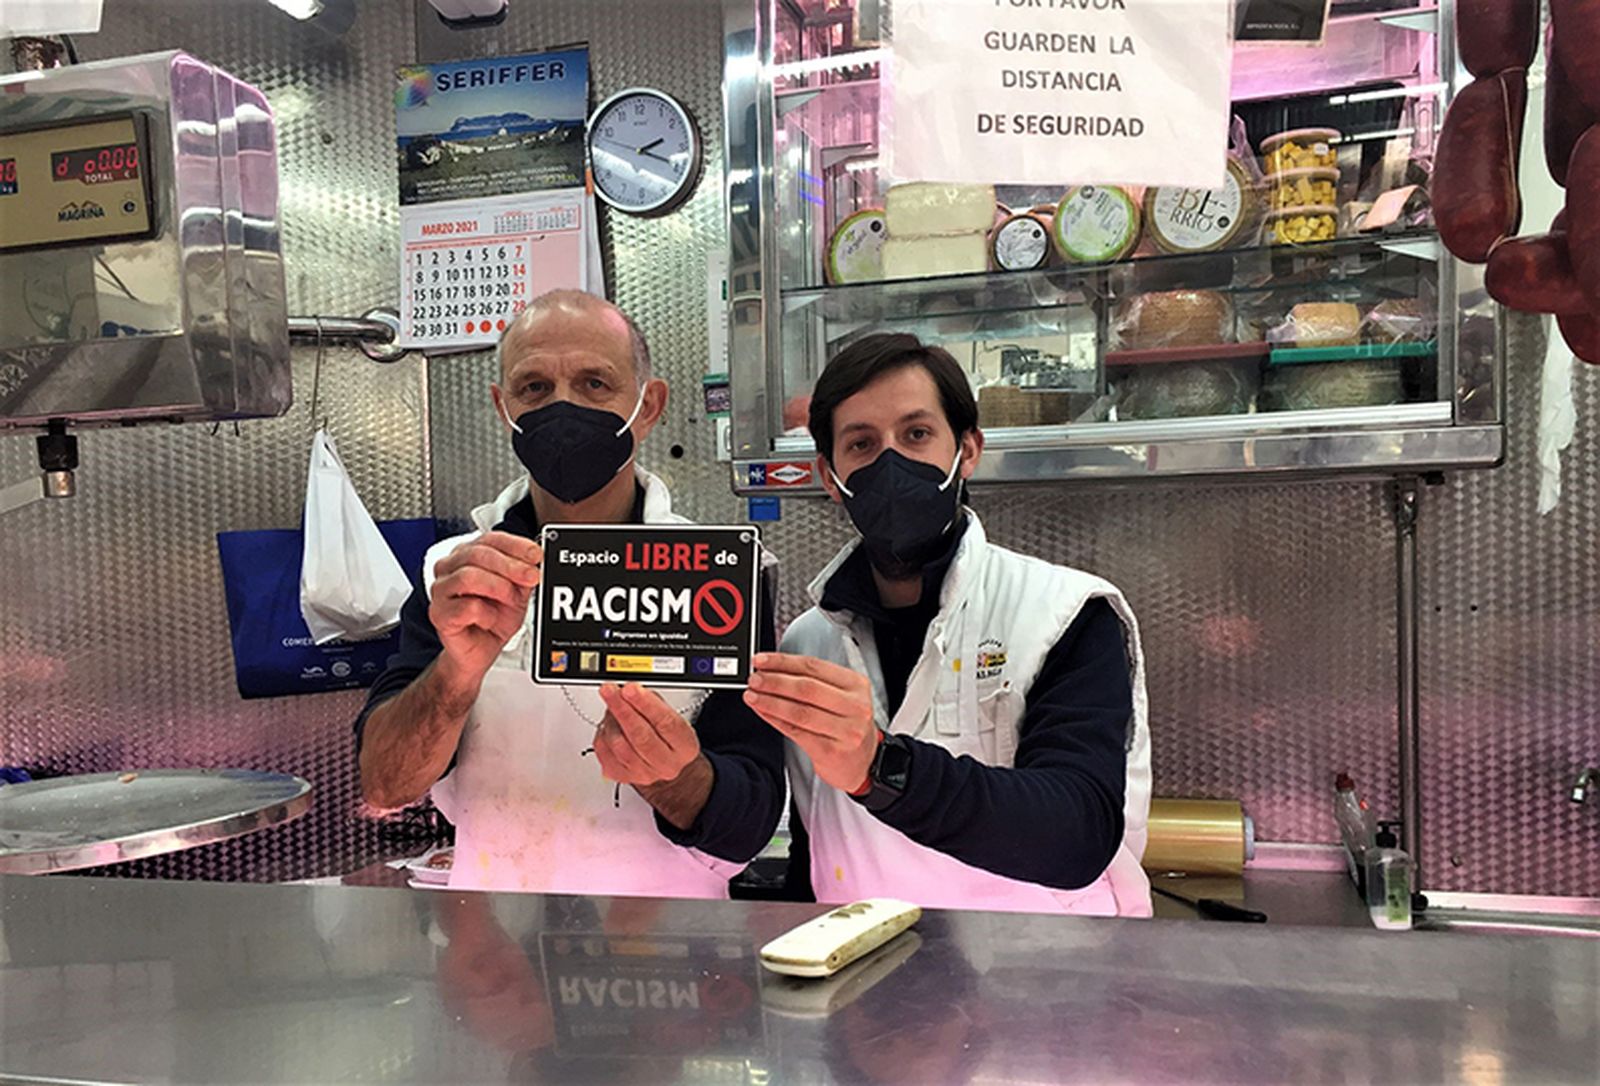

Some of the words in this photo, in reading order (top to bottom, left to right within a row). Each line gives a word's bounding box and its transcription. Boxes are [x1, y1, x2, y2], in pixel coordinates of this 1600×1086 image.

[984, 31, 1096, 53] GUARDEN
[1109, 36, 1135, 55] LA
[436, 62, 565, 92] SERIFFER
[1002, 70, 1122, 92] DISTANCIA
[634, 104, 645, 115] 12
[669, 118, 676, 129] 2
[977, 113, 1006, 134] DE
[1012, 114, 1145, 137] SEGURIDAD
[85, 174, 113, 182] TOTAL
[421, 222, 454, 236] MARZO
[455, 220, 478, 233] 2021
[417, 254, 422, 265] 1
[432, 252, 439, 264] 2
[449, 251, 455, 263] 3
[465, 250, 472, 262] 4
[482, 248, 488, 260] 5
[498, 247, 506, 259] 6
[515, 246, 522, 257] 7
[416, 272, 423, 284] 8
[432, 271, 439, 282] 9
[447, 270, 459, 281] 10
[464, 269, 474, 280] 11
[480, 267, 492, 279] 12
[497, 265, 508, 277] 13
[513, 264, 525, 276] 14
[414, 290, 426, 302] 15
[430, 289, 442, 300] 16
[447, 288, 459, 299] 17
[464, 286, 475, 297] 18
[480, 285, 492, 296] 19
[496, 284, 509, 295] 20
[513, 283, 525, 294] 21
[413, 307, 426, 319] 22
[429, 306, 442, 318] 23
[445, 305, 458, 316] 24
[463, 304, 475, 316] 25
[479, 303, 492, 314] 26
[496, 302, 509, 313] 27
[513, 301, 526, 312] 28
[413, 326, 426, 337] 29
[429, 325, 442, 335] 30
[446, 323, 458, 334] 31
[559, 550, 619, 566] Espacio
[625, 543, 709, 571] LIBRE
[715, 550, 738, 565] de
